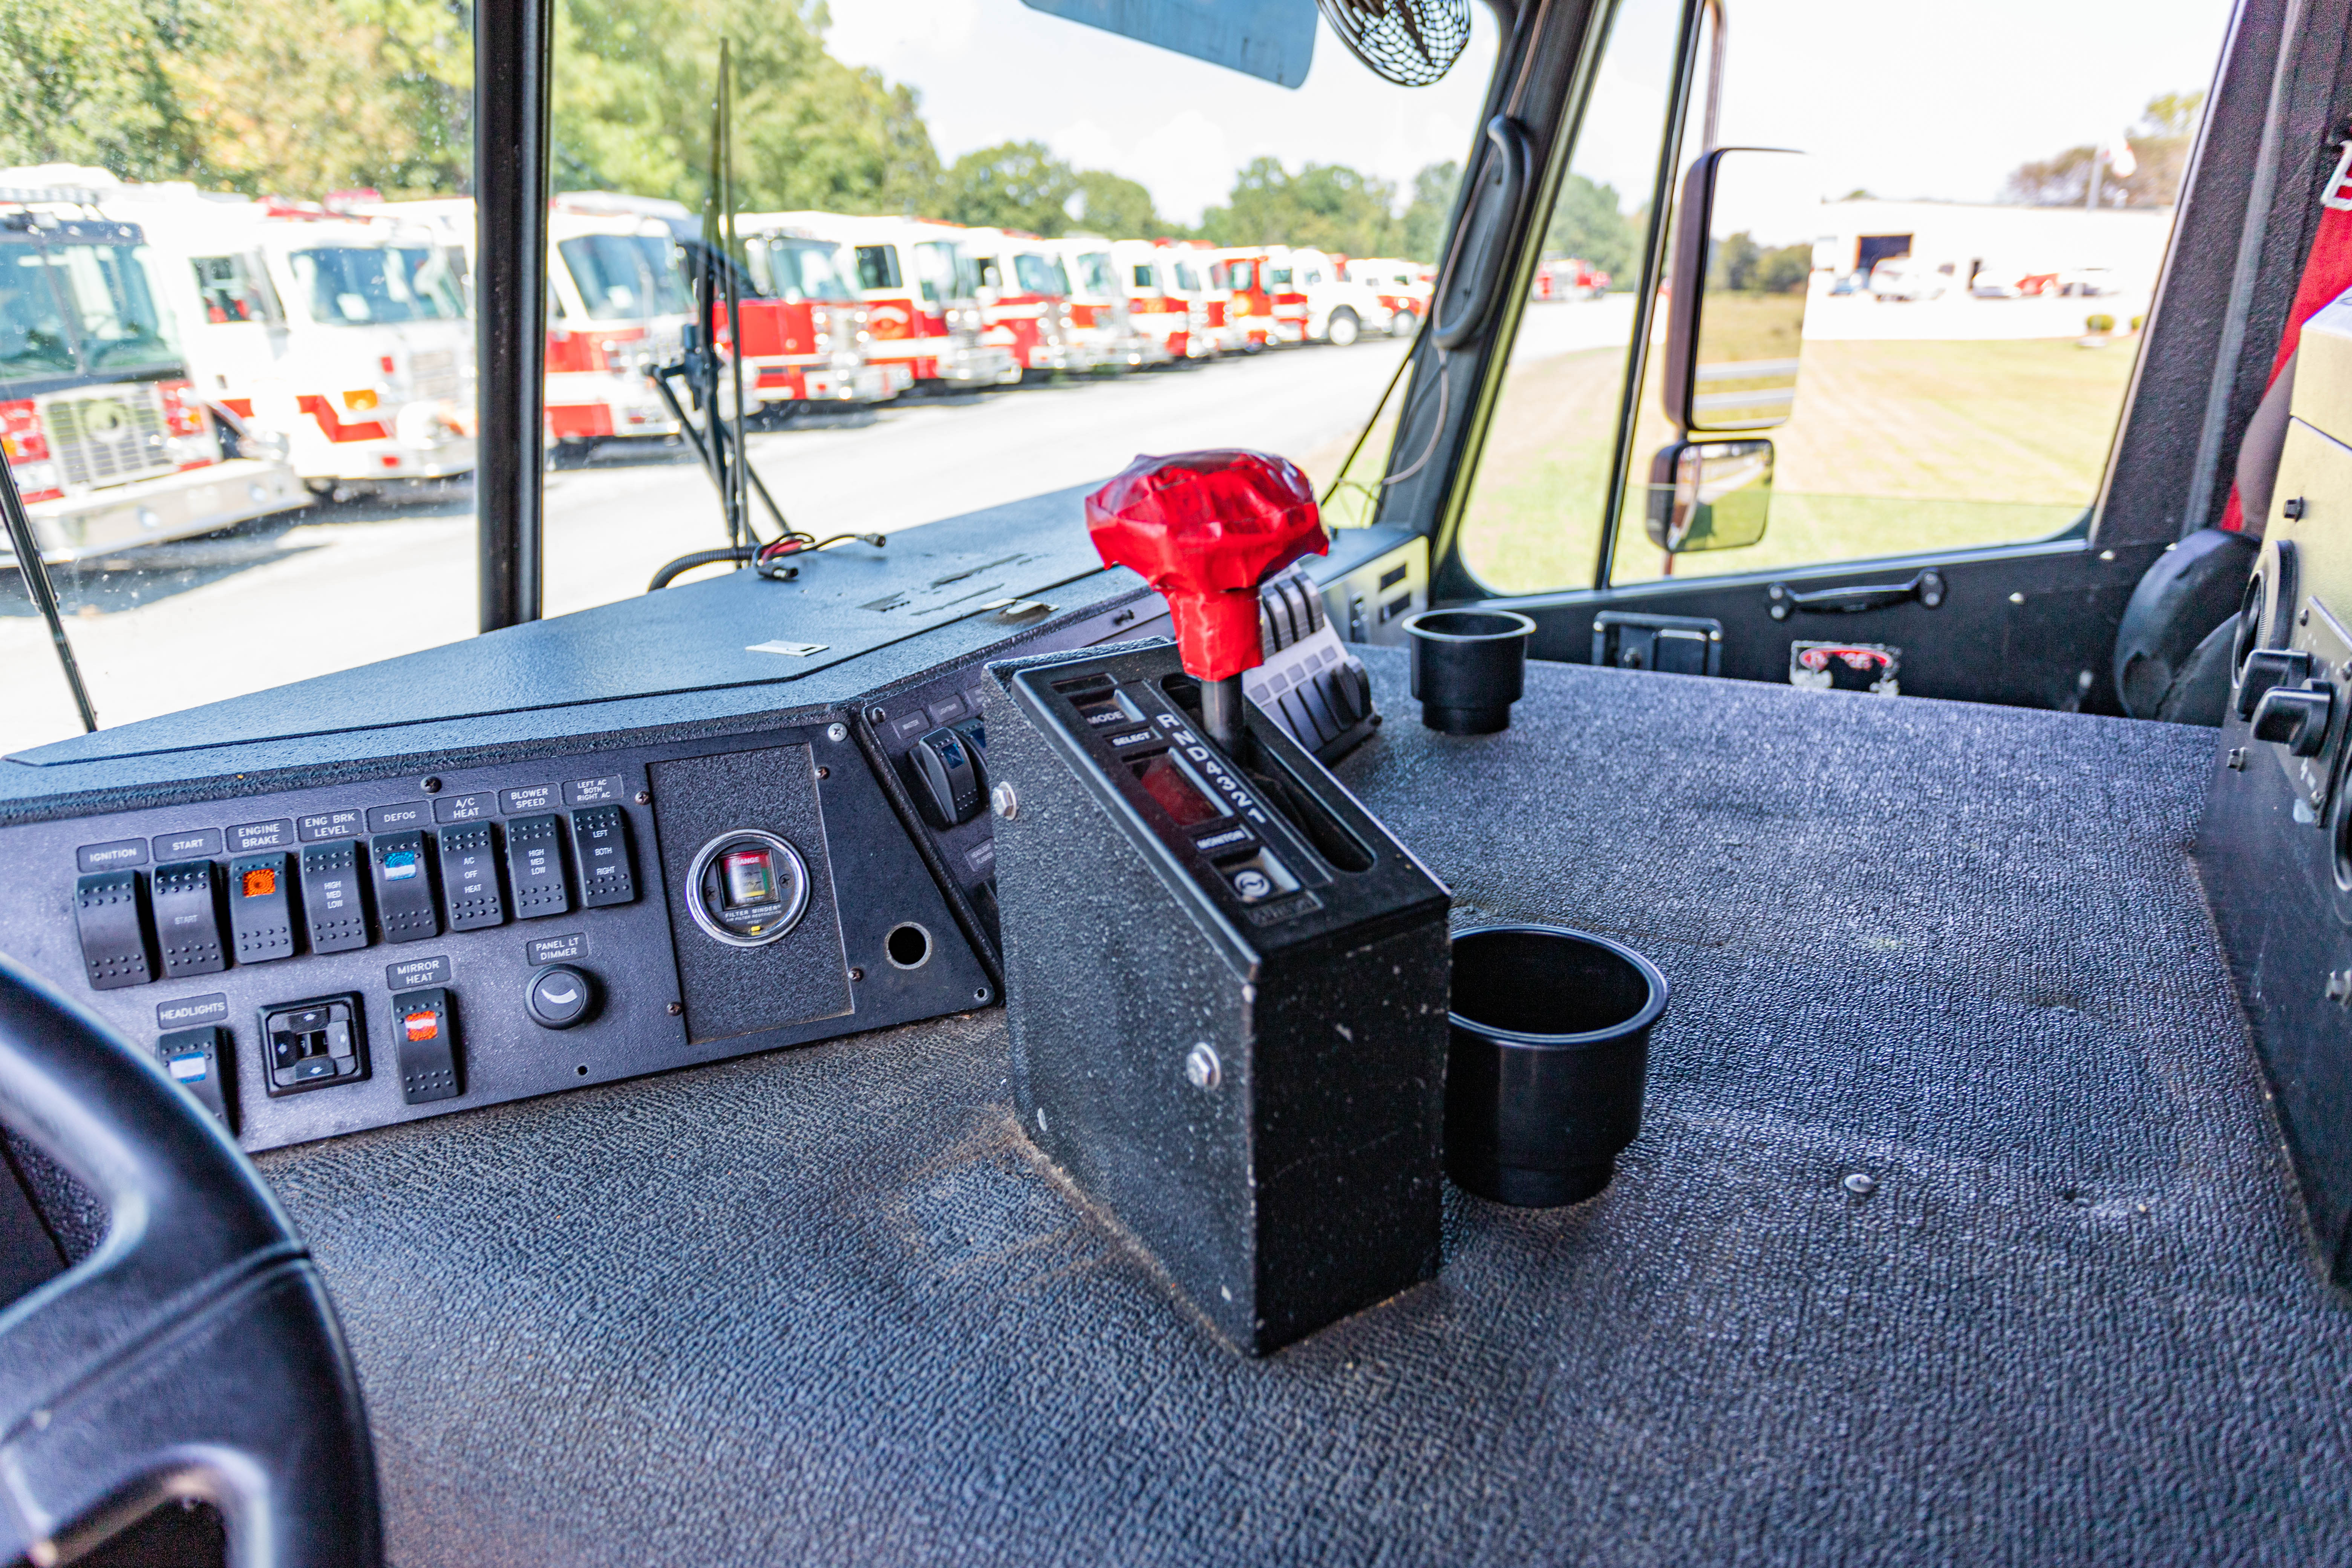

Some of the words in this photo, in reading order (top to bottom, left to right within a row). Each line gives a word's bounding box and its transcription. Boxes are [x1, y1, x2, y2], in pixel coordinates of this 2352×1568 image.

[1087, 710, 1125, 724] MODE
[1112, 732, 1151, 746] SELECT
[1156, 714, 1180, 728] R
[1172, 730, 1196, 746] N
[1186, 746, 1210, 762] D
[1206, 760, 1223, 776] 4
[1216, 775, 1237, 791] 3
[1231, 791, 1252, 808] 2
[1247, 807, 1266, 824] 1
[577, 781, 594, 790] LEFT
[583, 786, 603, 795] BOTH
[511, 787, 549, 801] BLOWER
[577, 793, 598, 802] RIGHT
[601, 791, 611, 799] AC
[455, 797, 476, 808] A/C
[515, 798, 546, 810] SPEED
[384, 810, 416, 823] DEFOG
[453, 807, 480, 819] HEAT
[305, 817, 328, 828] ENG
[332, 812, 355, 824] BRK
[238, 823, 280, 838] ENGINE
[314, 825, 349, 838] LEVEL
[593, 829, 608, 838] LEFT
[172, 838, 204, 850] START
[242, 835, 279, 848] BRAKE
[1196, 830, 1245, 850] MONITOR
[89, 848, 137, 862] IGNITION
[528, 848, 545, 858] HIGH
[594, 847, 612, 856] BOTH
[463, 857, 475, 865] A/C
[530, 858, 545, 866] MED
[464, 870, 478, 879] OFF
[531, 866, 546, 875] LOW
[596, 865, 615, 876] RIGHT
[324, 881, 341, 890] HIGH
[464, 884, 482, 894] HEAT
[326, 891, 341, 899] MED
[327, 900, 343, 909] LOW
[175, 915, 198, 924] START
[725, 910, 749, 919] FILTER
[536, 941, 565, 951] PANEL
[540, 947, 577, 960] DIMMER
[397, 960, 439, 975] MIRROR
[406, 972, 433, 985] HEAT
[160, 1002, 225, 1020] HEADLIGHTS
